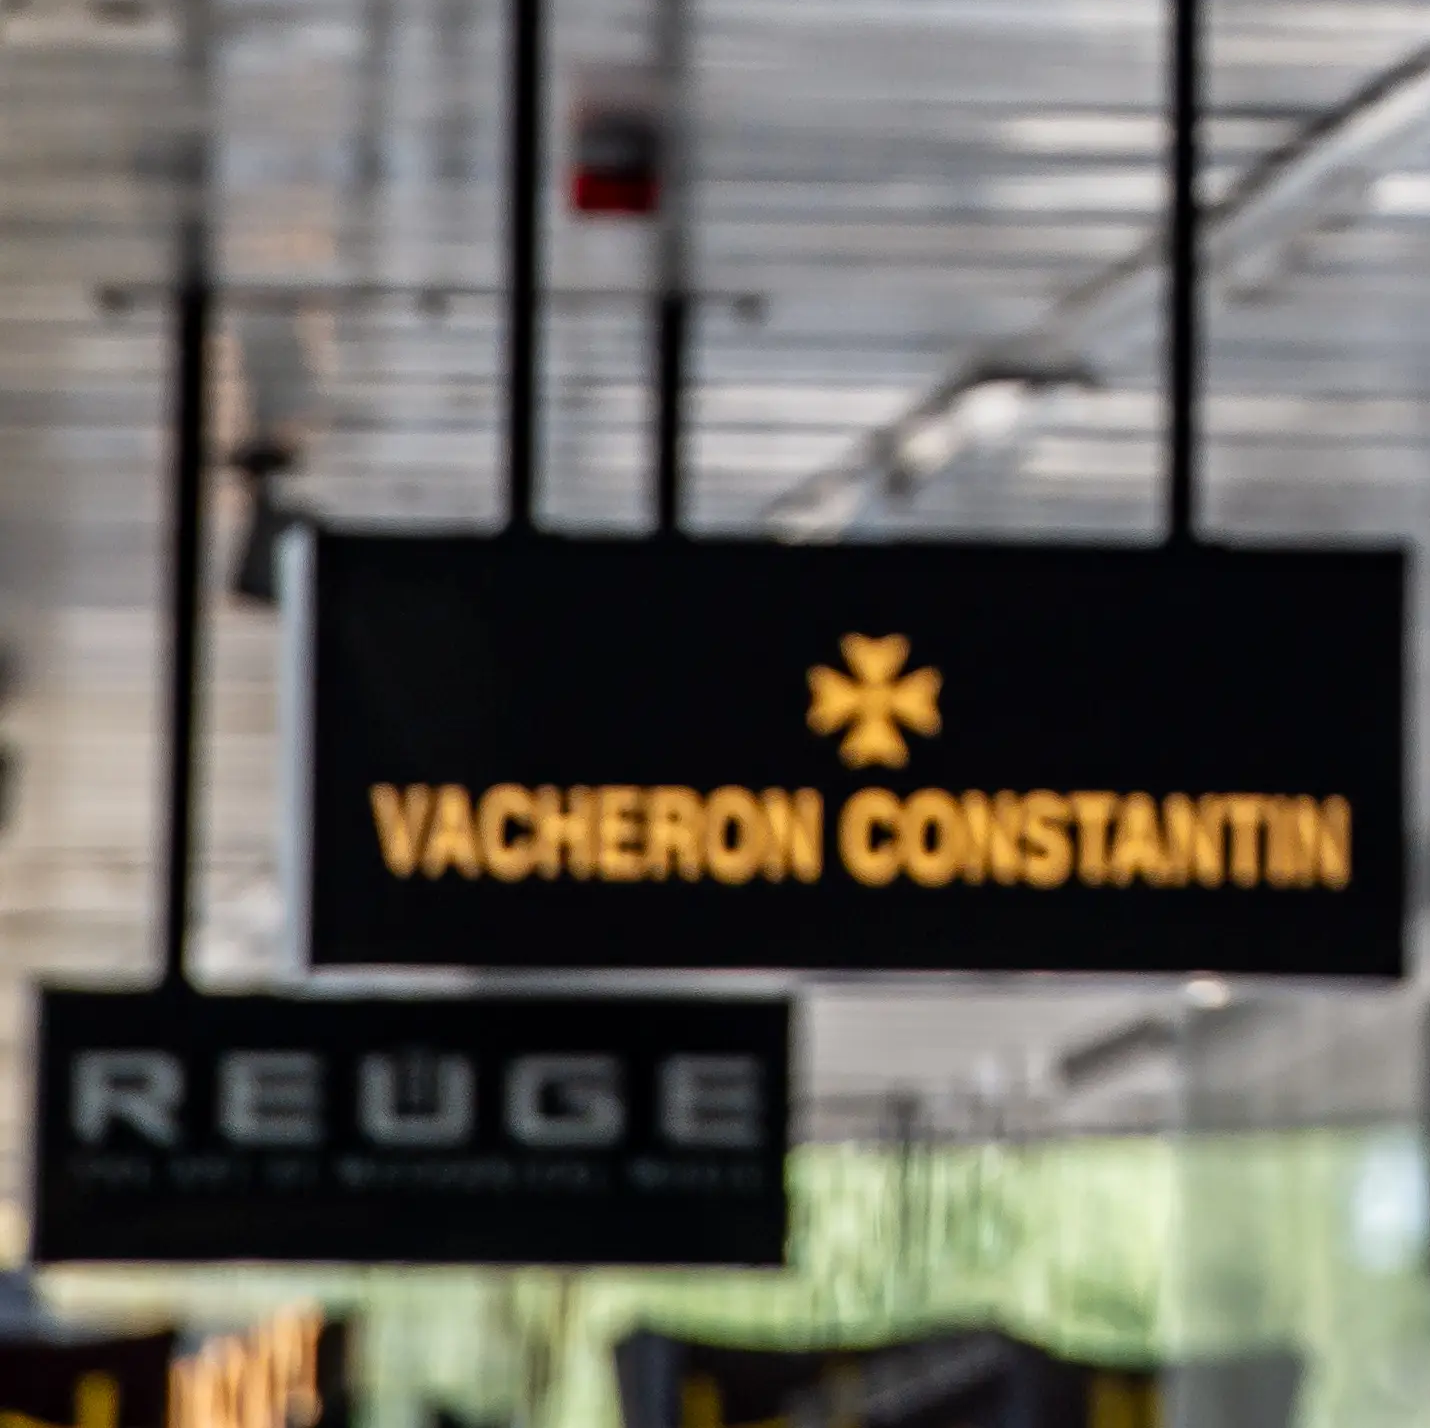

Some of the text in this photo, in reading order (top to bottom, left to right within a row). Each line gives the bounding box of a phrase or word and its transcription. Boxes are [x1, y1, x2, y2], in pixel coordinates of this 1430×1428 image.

[368, 782, 1352, 889] VACHERON CONSTANTIN
[70, 1048, 768, 1148] REUGE
